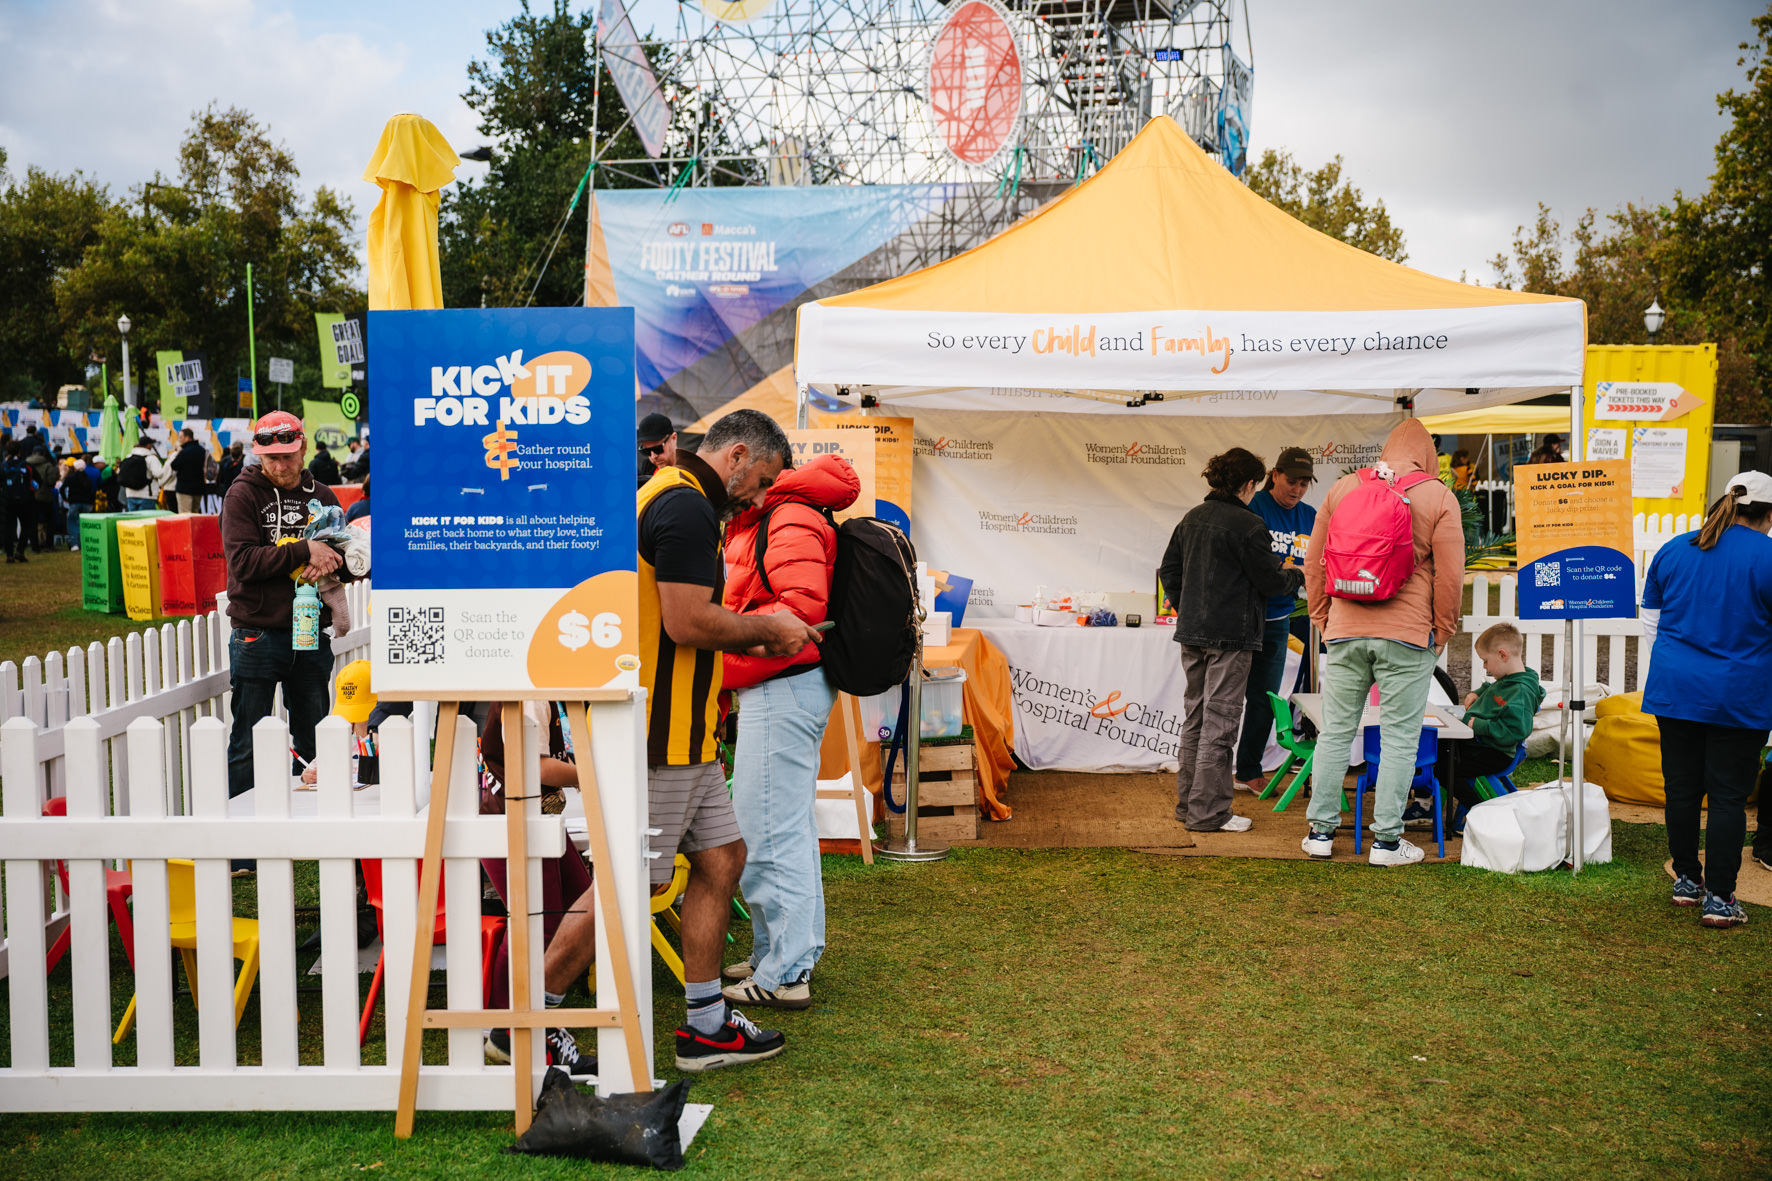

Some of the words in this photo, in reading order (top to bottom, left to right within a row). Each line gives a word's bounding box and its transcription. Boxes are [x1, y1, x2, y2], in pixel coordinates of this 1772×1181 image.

[715, 225, 756, 235] Macca's
[640, 241, 696, 271] FOOTY
[698, 241, 779, 272] FESTIVAL
[655, 271, 709, 281] GATHER
[711, 271, 761, 282] ROUND
[332, 320, 361, 342] GREAT
[927, 331, 955, 349] So
[962, 335, 1027, 354] every
[1032, 324, 1096, 358] Child
[1099, 331, 1144, 351] and
[1241, 333, 1283, 352] has
[1290, 336, 1356, 355] every
[1363, 331, 1448, 351] chance
[337, 342, 364, 363] GOAL!
[167, 365, 175, 384] A
[431, 349, 532, 397] KICK
[536, 365, 573, 395] IT
[1615, 388, 1657, 396] PRE-BOOKED
[414, 397, 489, 426] FOR
[500, 395, 591, 425] KIDS
[874, 425, 894, 434] DIP.
[319, 430, 347, 445] AFL
[913, 437, 935, 447] men's
[947, 439, 994, 450] Children's
[1594, 438, 1612, 447] SIGN
[1613, 439, 1619, 447] A
[517, 445, 554, 456] Gather
[556, 444, 591, 455] round
[813, 442, 844, 454] DIP.
[938, 449, 992, 460] Foundation
[1085, 443, 1128, 455] Women's
[1141, 444, 1187, 456] Children's
[1335, 443, 1382, 454] Children's
[1592, 447, 1619, 455] WAIVER
[517, 459, 543, 471] your
[545, 458, 593, 471] hospital.
[1087, 453, 1128, 466] Hospital
[1130, 454, 1186, 466] Foundation
[1326, 454, 1381, 465] Foundation
[1537, 471, 1577, 482] LUCKY
[1582, 469, 1607, 479] DIP.
[266, 512, 276, 523] 19
[412, 516, 438, 525] KICK
[440, 516, 451, 525] IT
[453, 516, 475, 525] FOR
[478, 516, 504, 525] KIDS
[506, 515, 514, 525] is
[516, 514, 528, 525] all
[529, 514, 557, 525] about
[559, 514, 596, 526] helping
[978, 510, 1020, 523] Women's
[1030, 513, 1078, 525] Children's
[404, 528, 424, 538] kids
[425, 529, 441, 540] get
[443, 527, 465, 538] back
[467, 527, 494, 537] home
[495, 529, 506, 537] to
[508, 527, 531, 537] what
[533, 527, 555, 538] they
[557, 526, 579, 537] love,
[580, 526, 604, 536] their
[980, 521, 1019, 533] Hospital
[1022, 523, 1077, 535] Foundation
[408, 540, 448, 551] families,
[449, 540, 472, 550] their
[474, 540, 525, 551] backyards,
[526, 540, 544, 550] and
[546, 539, 569, 549] their
[571, 539, 600, 550] footy!
[1270, 541, 1288, 554] OR
[1595, 565, 1605, 573] QR
[1334, 578, 1374, 595] PUMA
[461, 611, 492, 624] Scan
[495, 611, 517, 624] the
[453, 628, 476, 643] QR
[477, 627, 509, 641] code
[511, 629, 525, 641] to
[557, 609, 622, 652] $6
[465, 646, 513, 659] donate.
[1009, 665, 1097, 709] Women's
[1090, 690, 1130, 719] &
[1123, 702, 1184, 737] Childr
[880, 728, 890, 737] 30
[1094, 717, 1179, 758] Foundat
